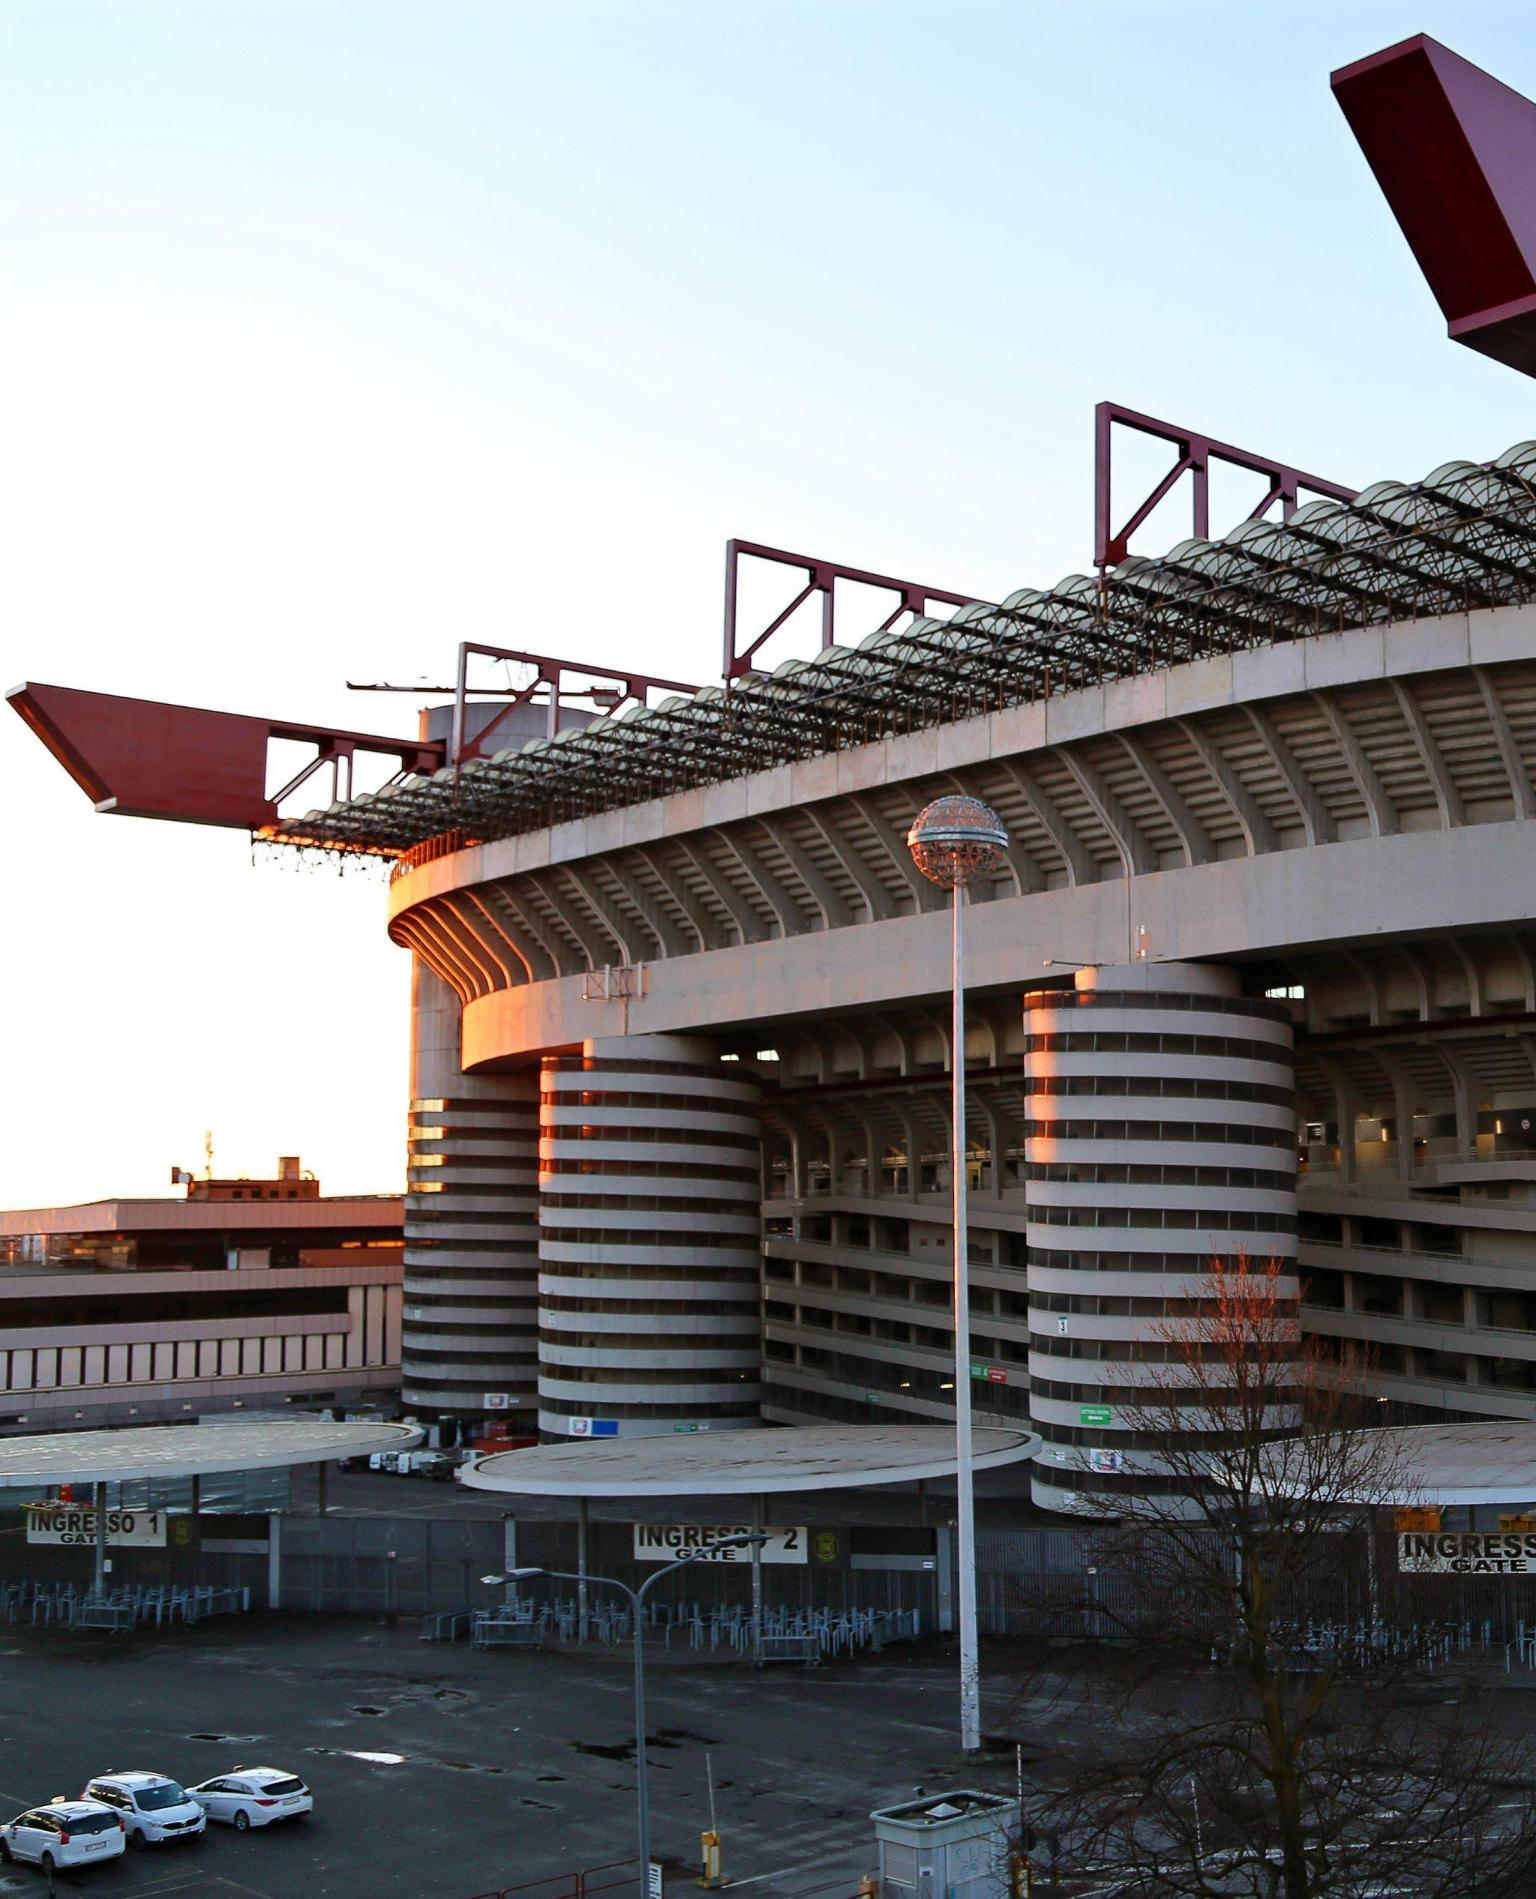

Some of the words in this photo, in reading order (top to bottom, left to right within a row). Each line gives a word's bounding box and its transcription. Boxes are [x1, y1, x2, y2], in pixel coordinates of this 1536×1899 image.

[31, 1513, 135, 1534] INGRESO
[149, 1514, 158, 1534] 1
[783, 1528, 798, 1550] 2
[675, 1548, 735, 1560] GATE
[1452, 1559, 1527, 1572] GATE
